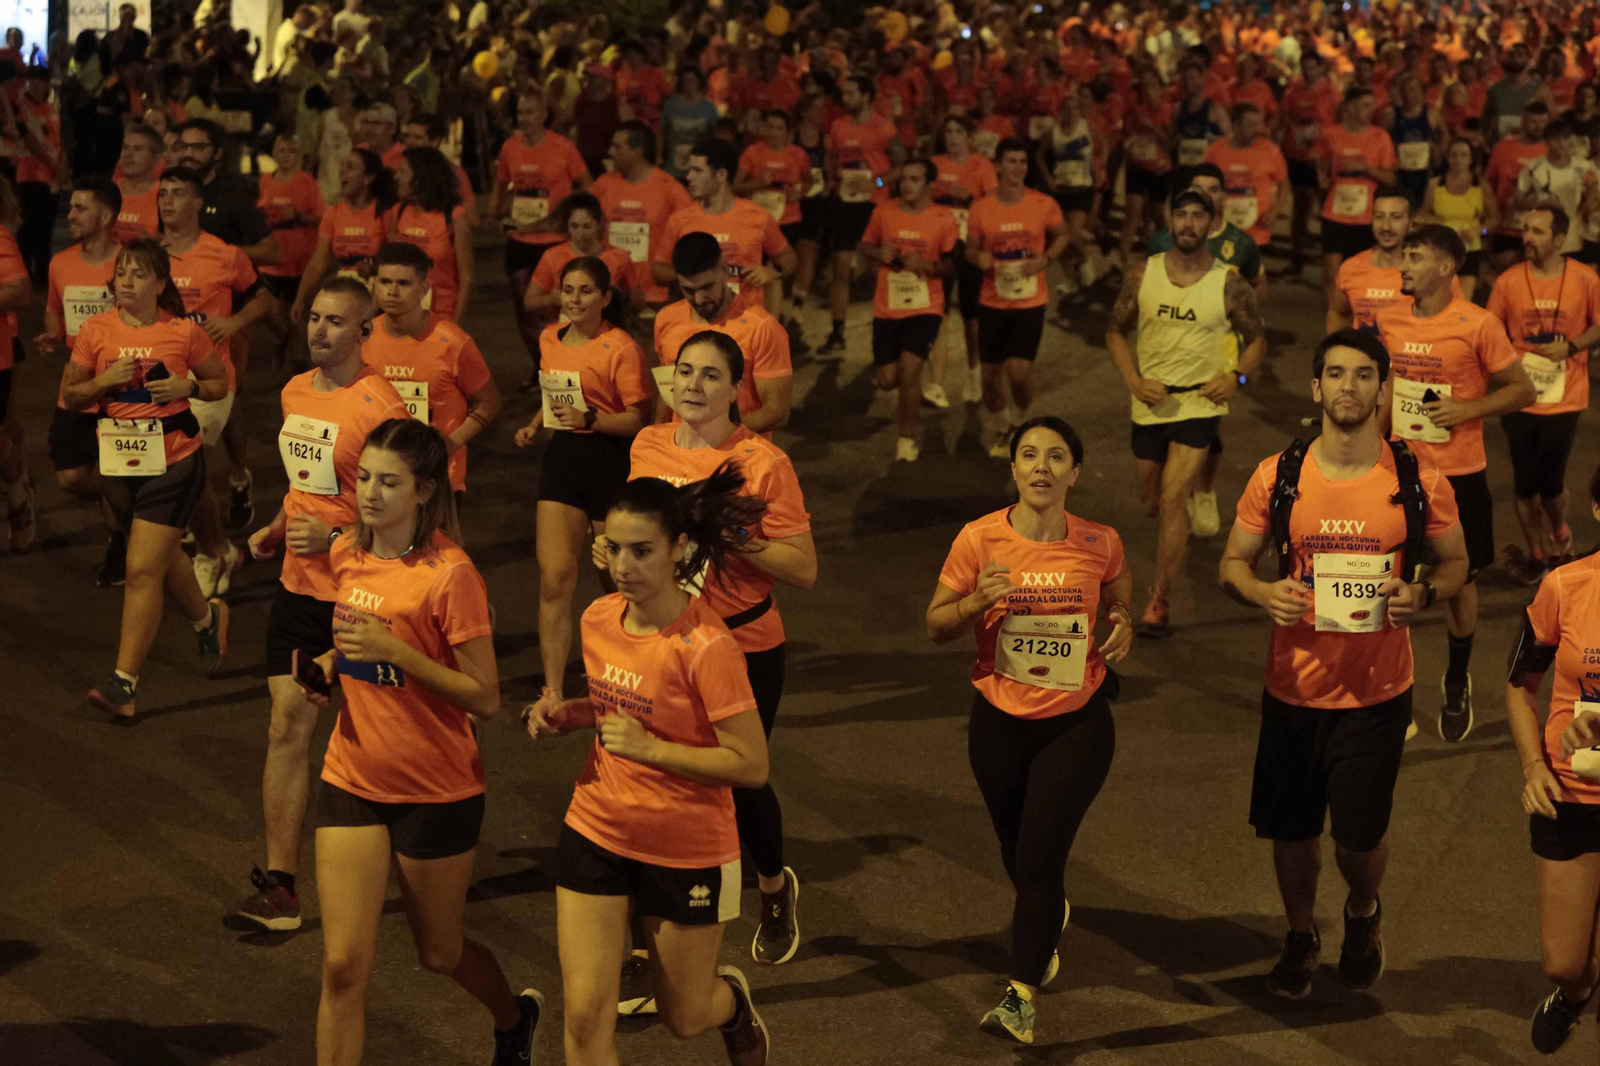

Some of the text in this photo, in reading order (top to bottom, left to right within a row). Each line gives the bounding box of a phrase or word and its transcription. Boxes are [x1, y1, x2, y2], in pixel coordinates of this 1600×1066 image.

[1157, 304, 1196, 321] FILA
[119, 346, 153, 359] XXXV
[1402, 341, 1434, 355] XXXV
[384, 365, 415, 378] XXXV
[115, 439, 148, 452] 9442
[288, 441, 322, 463] 16214
[1319, 519, 1366, 535] XXXV
[1301, 534, 1381, 545] CARRERA NOCTURNA
[1307, 541, 1381, 552] GUADALQUIVIR
[1021, 571, 1066, 587] XXXV
[347, 587, 384, 611] XXXV
[1008, 595, 1083, 604] GUADALQUIVIR
[1012, 638, 1072, 658] 21230
[602, 662, 643, 692] XXXV
[589, 685, 653, 716] GUADALQUIVIR
[615, 687, 653, 706] NOCTURNA
